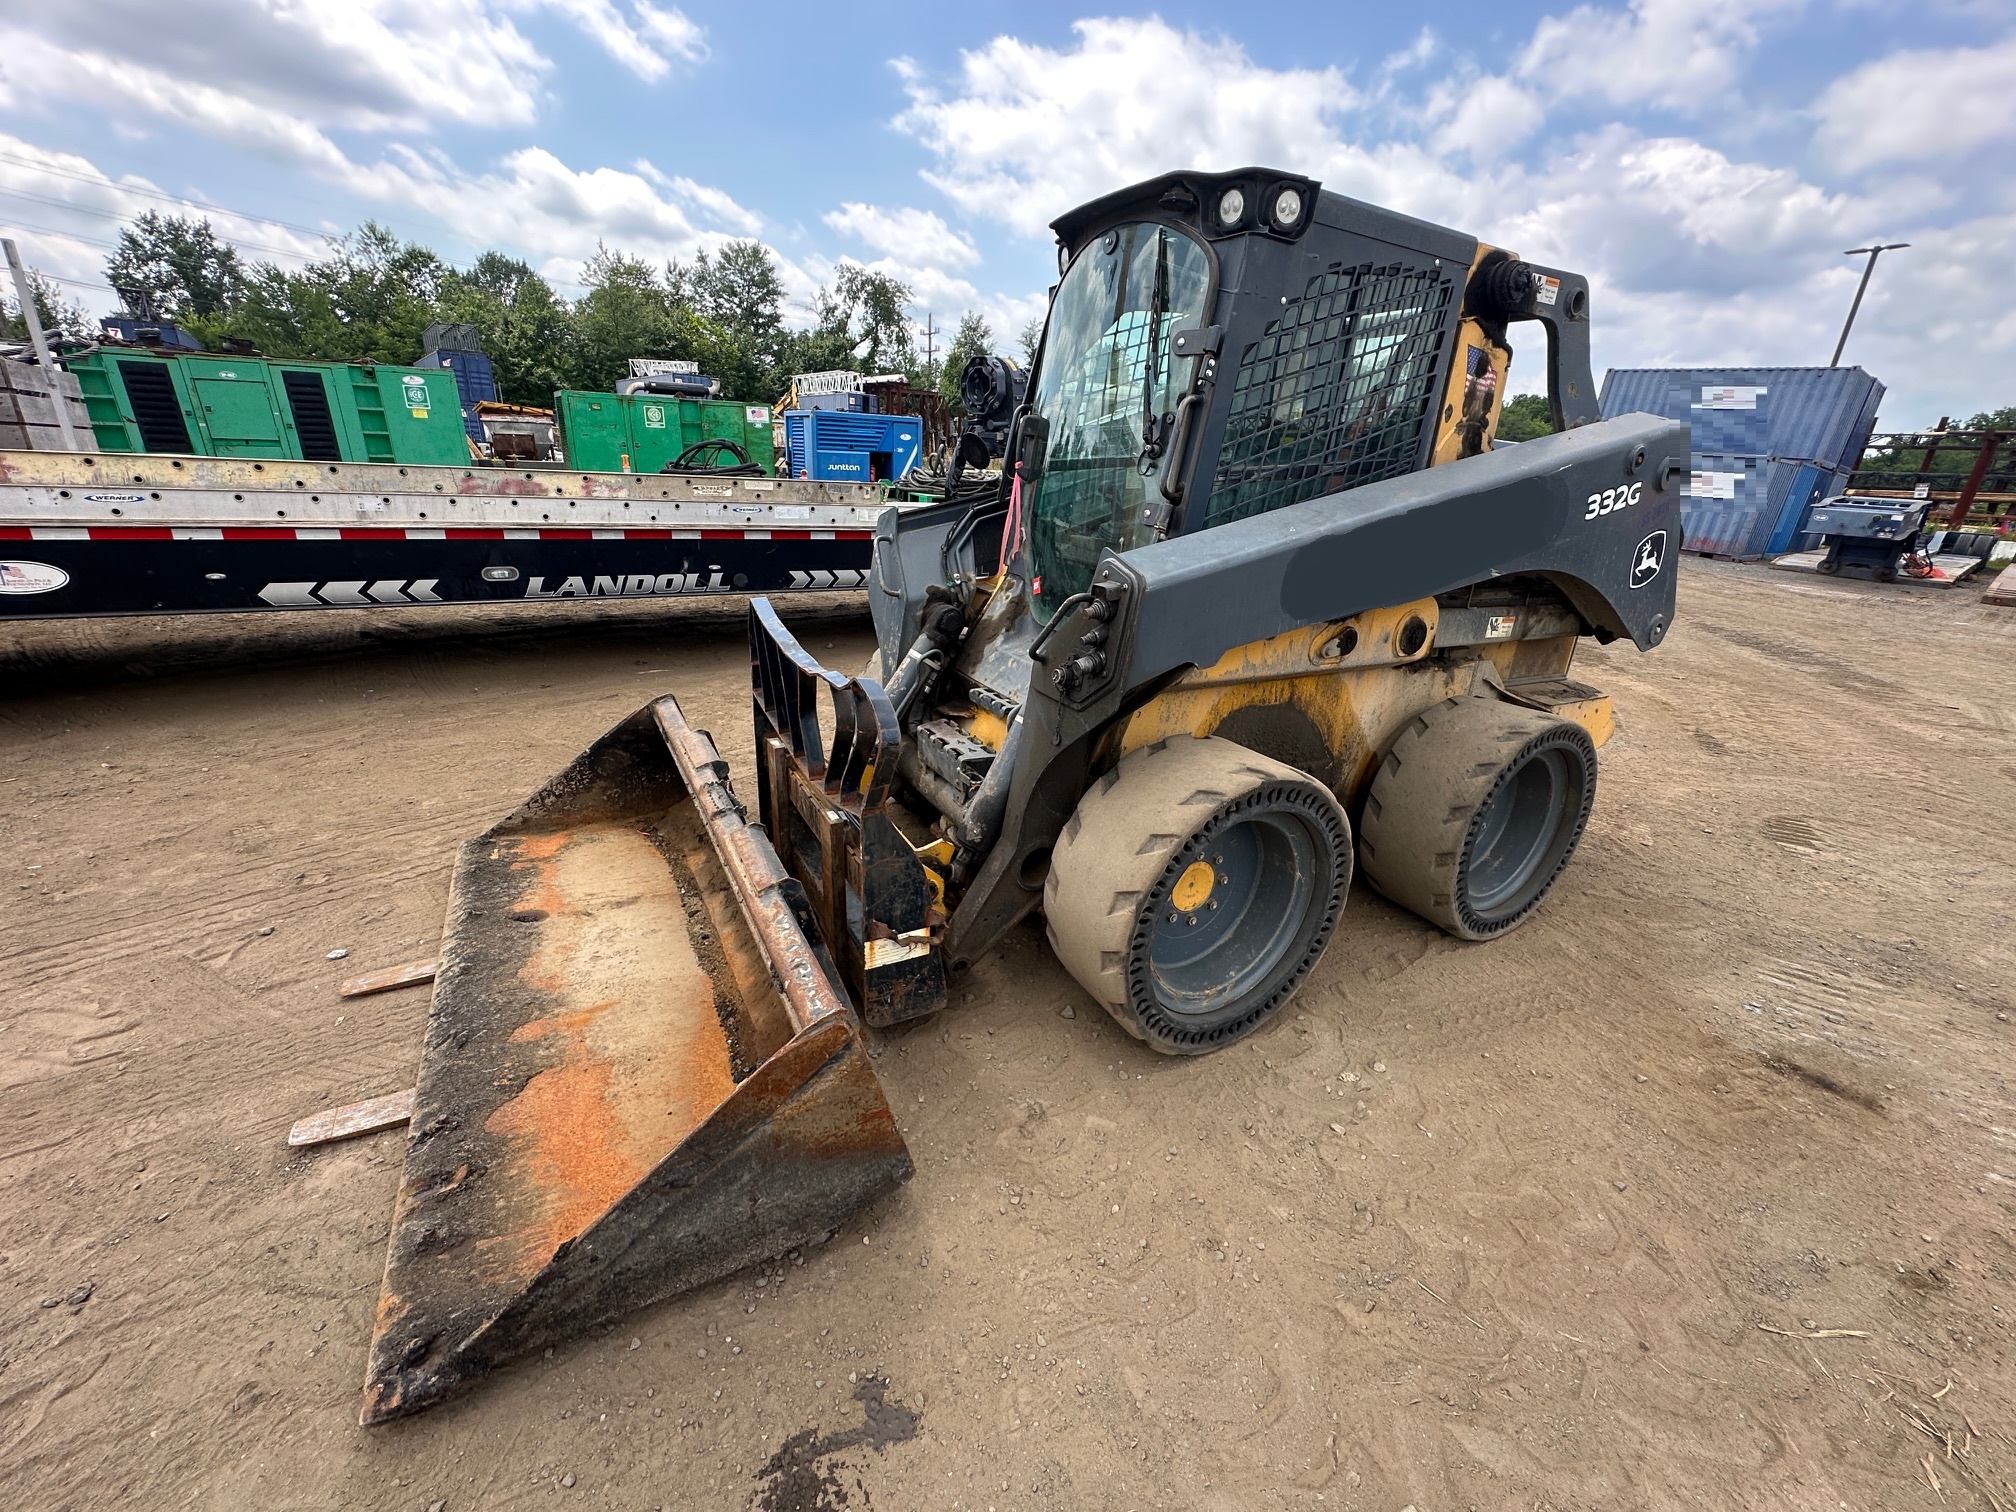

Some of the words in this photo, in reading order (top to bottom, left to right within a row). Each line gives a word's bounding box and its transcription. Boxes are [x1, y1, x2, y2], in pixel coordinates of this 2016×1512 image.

[110, 329, 119, 337] 7
[1585, 482, 1642, 520] 332G
[524, 572, 731, 597] LANDOLL
